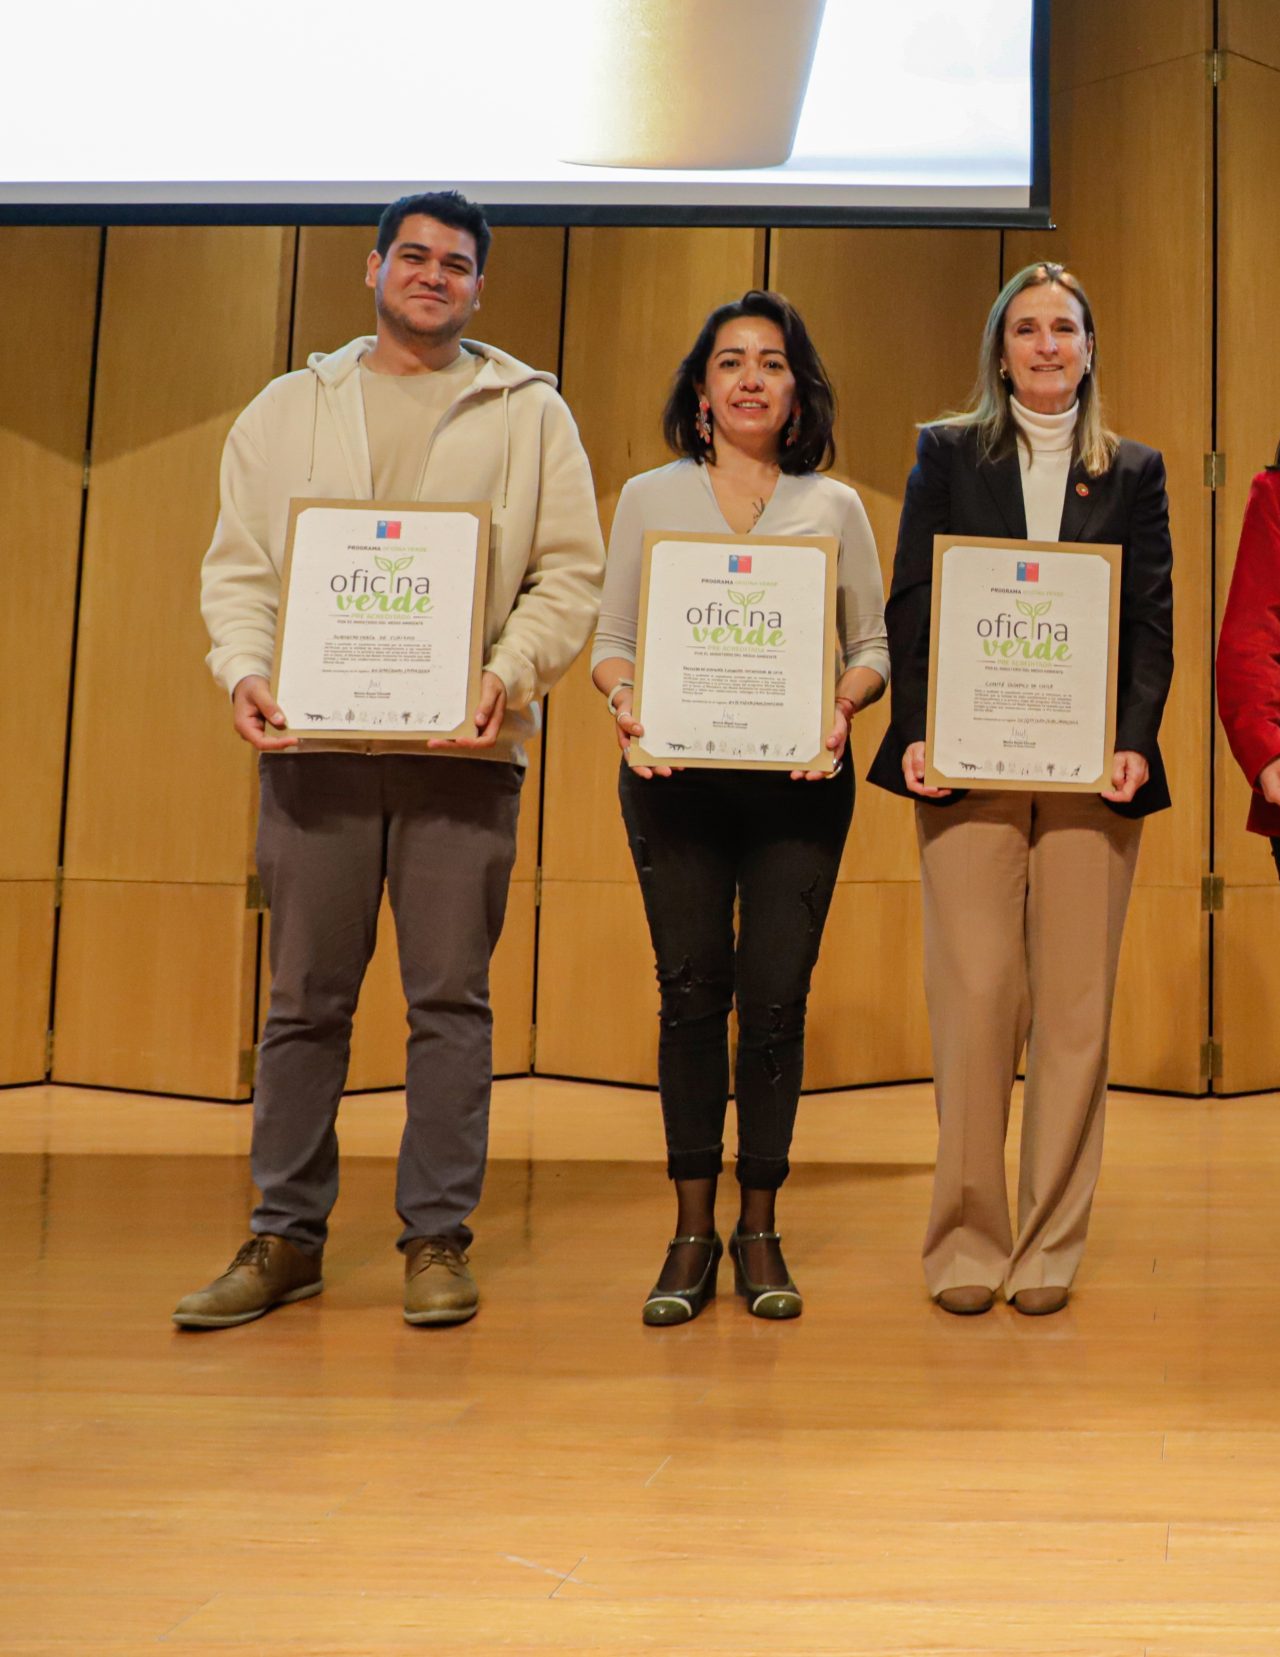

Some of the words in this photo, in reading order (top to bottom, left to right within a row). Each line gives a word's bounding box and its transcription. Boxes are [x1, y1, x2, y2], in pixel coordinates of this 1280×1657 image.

[330, 556, 430, 595] oficina
[336, 586, 434, 614] verde
[686, 589, 782, 628] oficina
[692, 622, 786, 647] verde
[976, 599, 1068, 642] oficina
[982, 634, 1072, 661] verde
